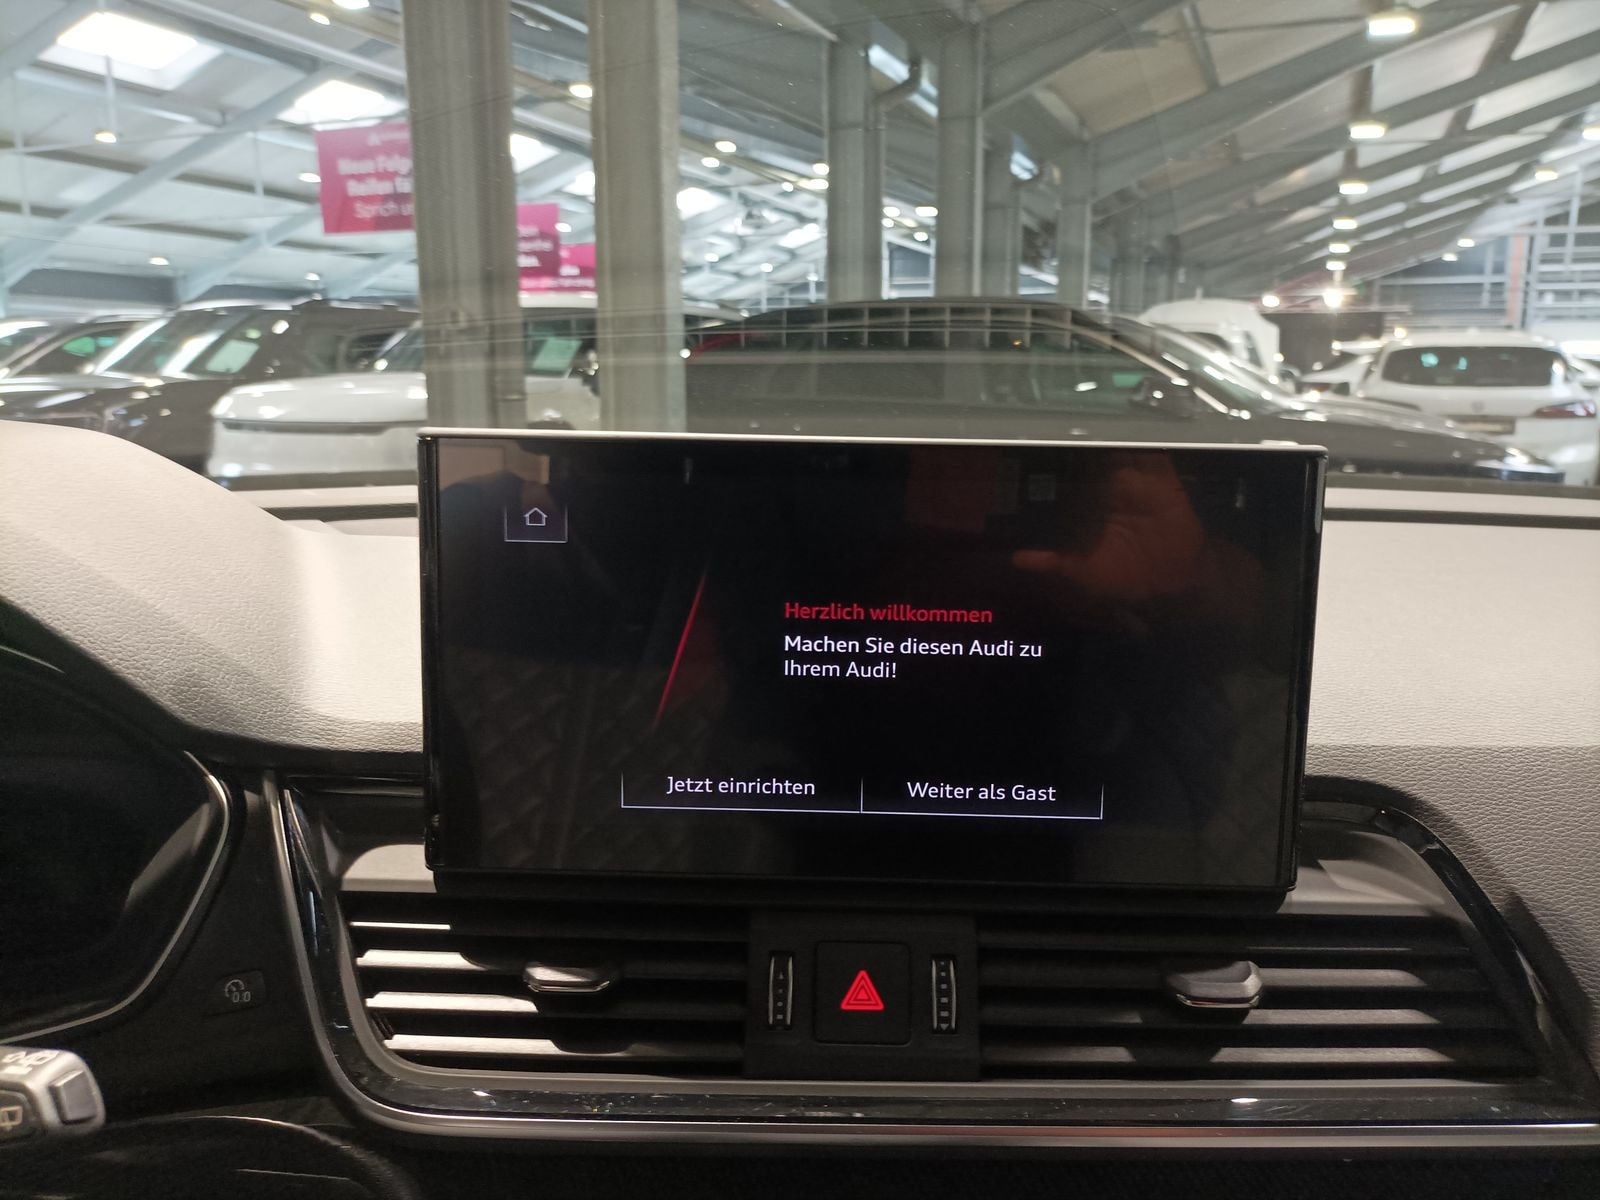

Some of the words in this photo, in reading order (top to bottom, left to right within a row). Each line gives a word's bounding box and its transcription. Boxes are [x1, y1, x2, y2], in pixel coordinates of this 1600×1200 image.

[785, 602, 865, 620] Herzlich
[869, 604, 993, 623] willkommen
[784, 635, 860, 653] Machen
[865, 637, 895, 654] Sie
[899, 637, 964, 656] diesen
[968, 639, 1014, 657] Audi
[1019, 644, 1042, 658] zu
[784, 660, 841, 677] Ihrem
[845, 661, 897, 679] Audi!
[665, 776, 714, 795] Jetzt
[718, 778, 815, 796] einrichten
[906, 781, 974, 799] Weiter
[978, 783, 1006, 800] als
[1011, 784, 1057, 802] Gast
